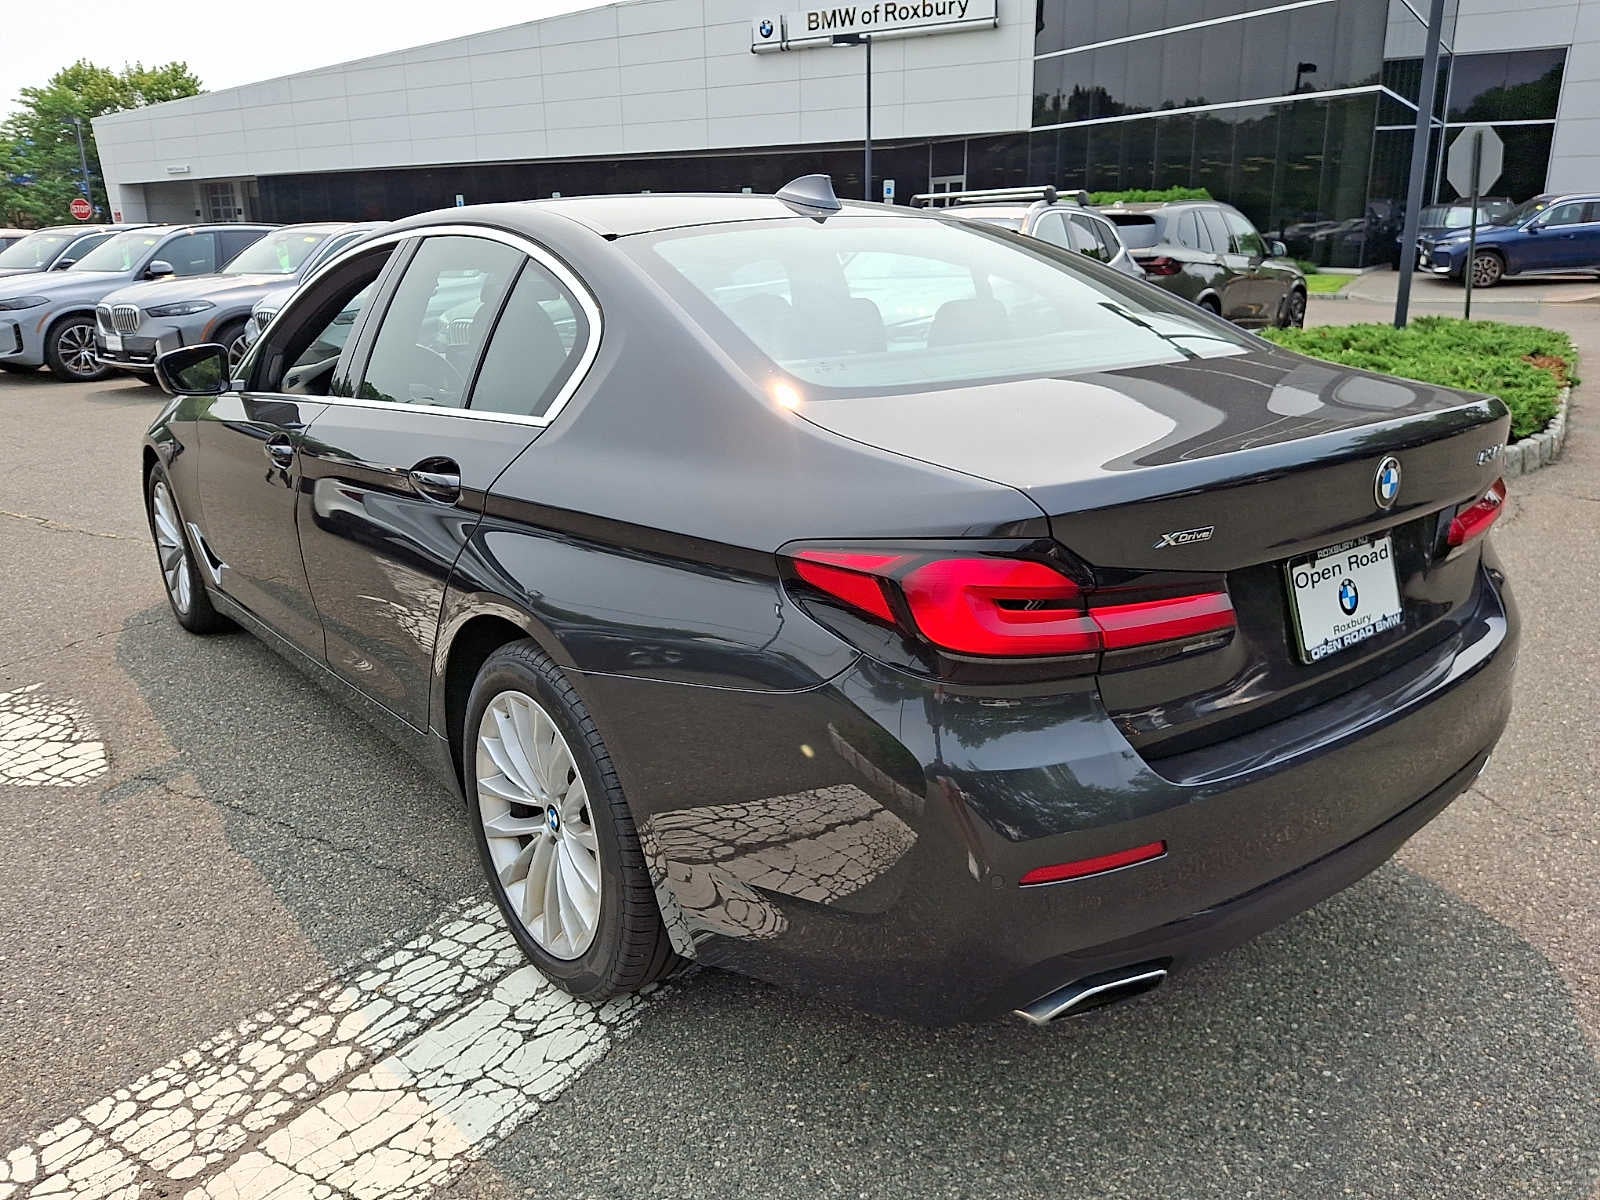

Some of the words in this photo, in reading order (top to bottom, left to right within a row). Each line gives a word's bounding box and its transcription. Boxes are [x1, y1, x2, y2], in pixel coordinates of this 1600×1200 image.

[807, 7, 857, 31] BMW
[861, 4, 881, 24] of
[884, 0, 969, 22] Roxbury
[71, 205, 90, 213] STOP
[1295, 564, 1342, 589] Open
[1347, 544, 1389, 571] Road
[1311, 638, 1341, 660] OPEN
[1343, 624, 1374, 646] ROAD
[1376, 613, 1401, 632] BMW
[1332, 614, 1371, 635] Roxbury
